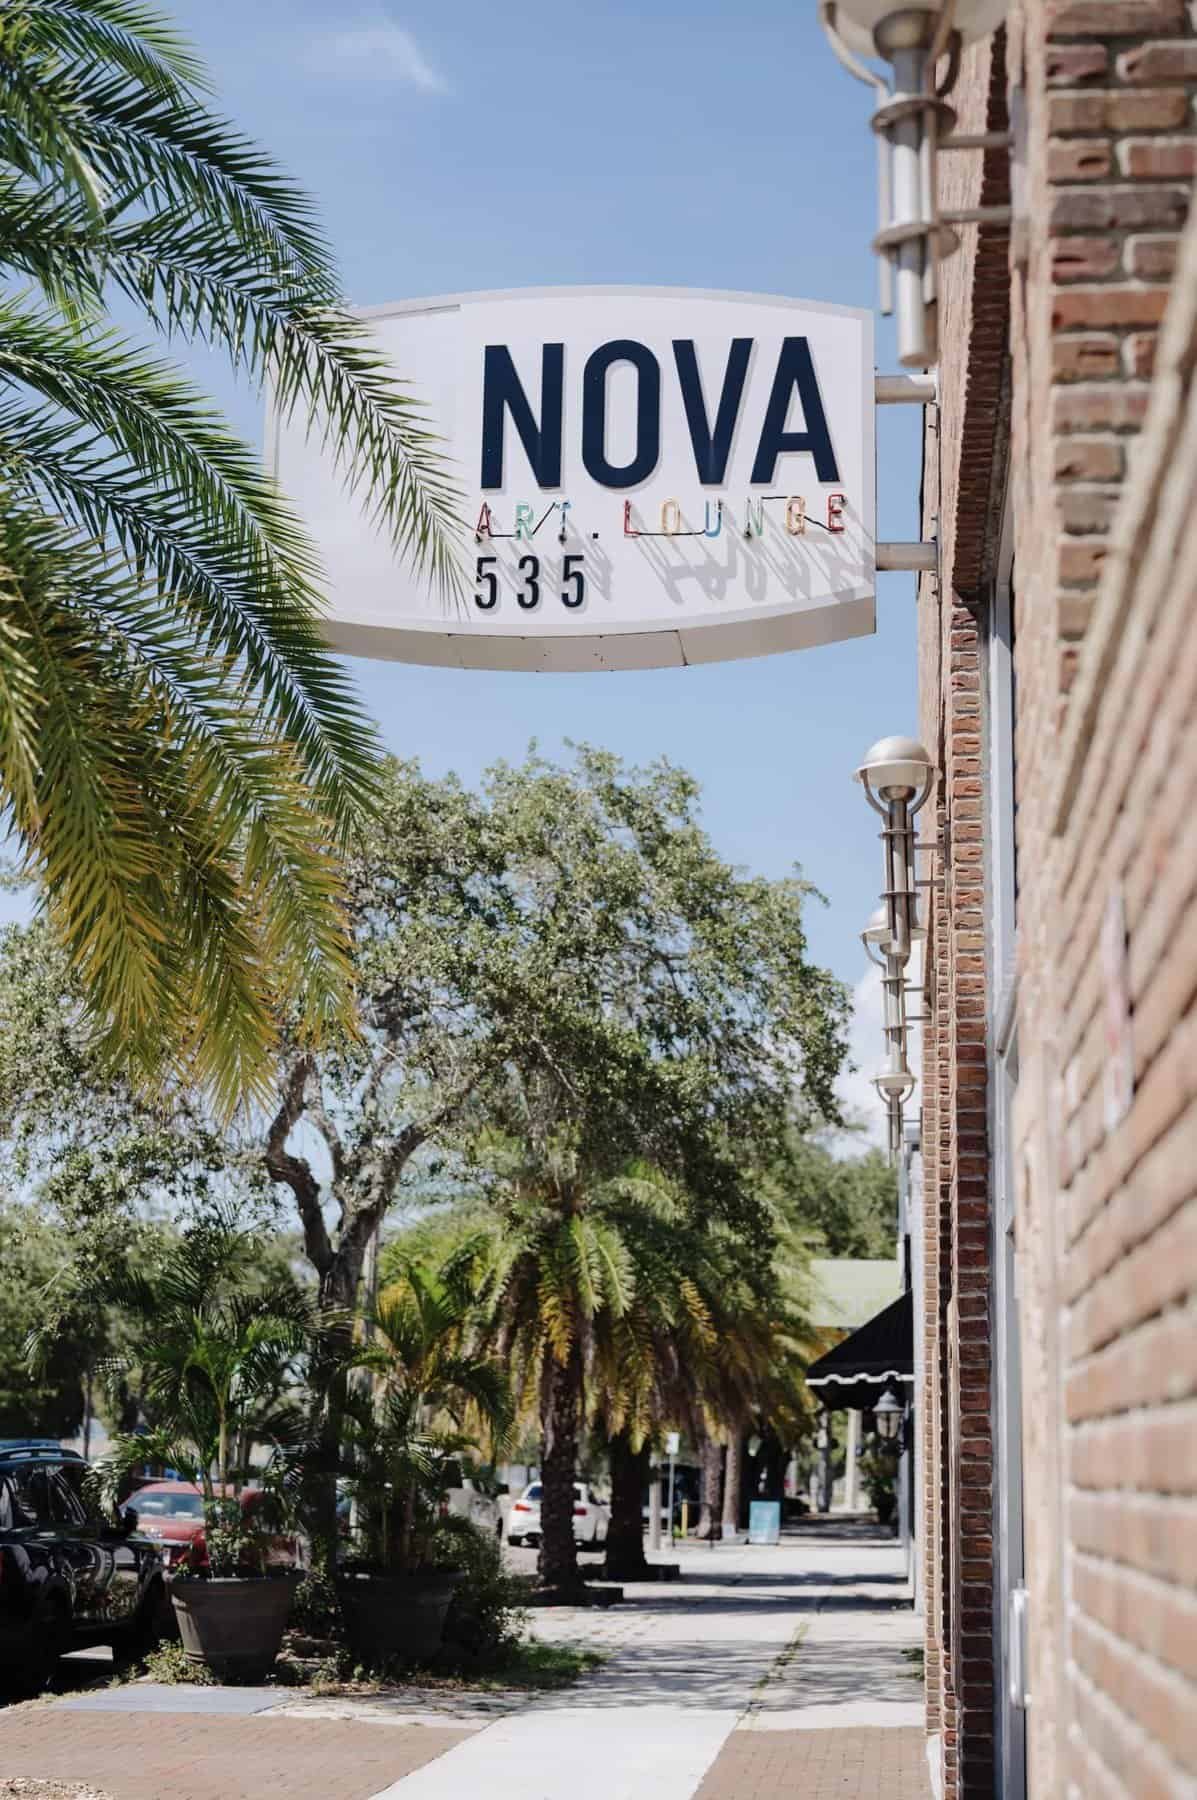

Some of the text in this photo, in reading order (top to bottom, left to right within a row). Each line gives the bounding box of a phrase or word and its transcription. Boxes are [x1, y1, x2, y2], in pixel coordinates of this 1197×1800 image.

[481, 336, 840, 489] NOVA
[623, 494, 846, 538] LOUNGE
[475, 554, 585, 609] 535
